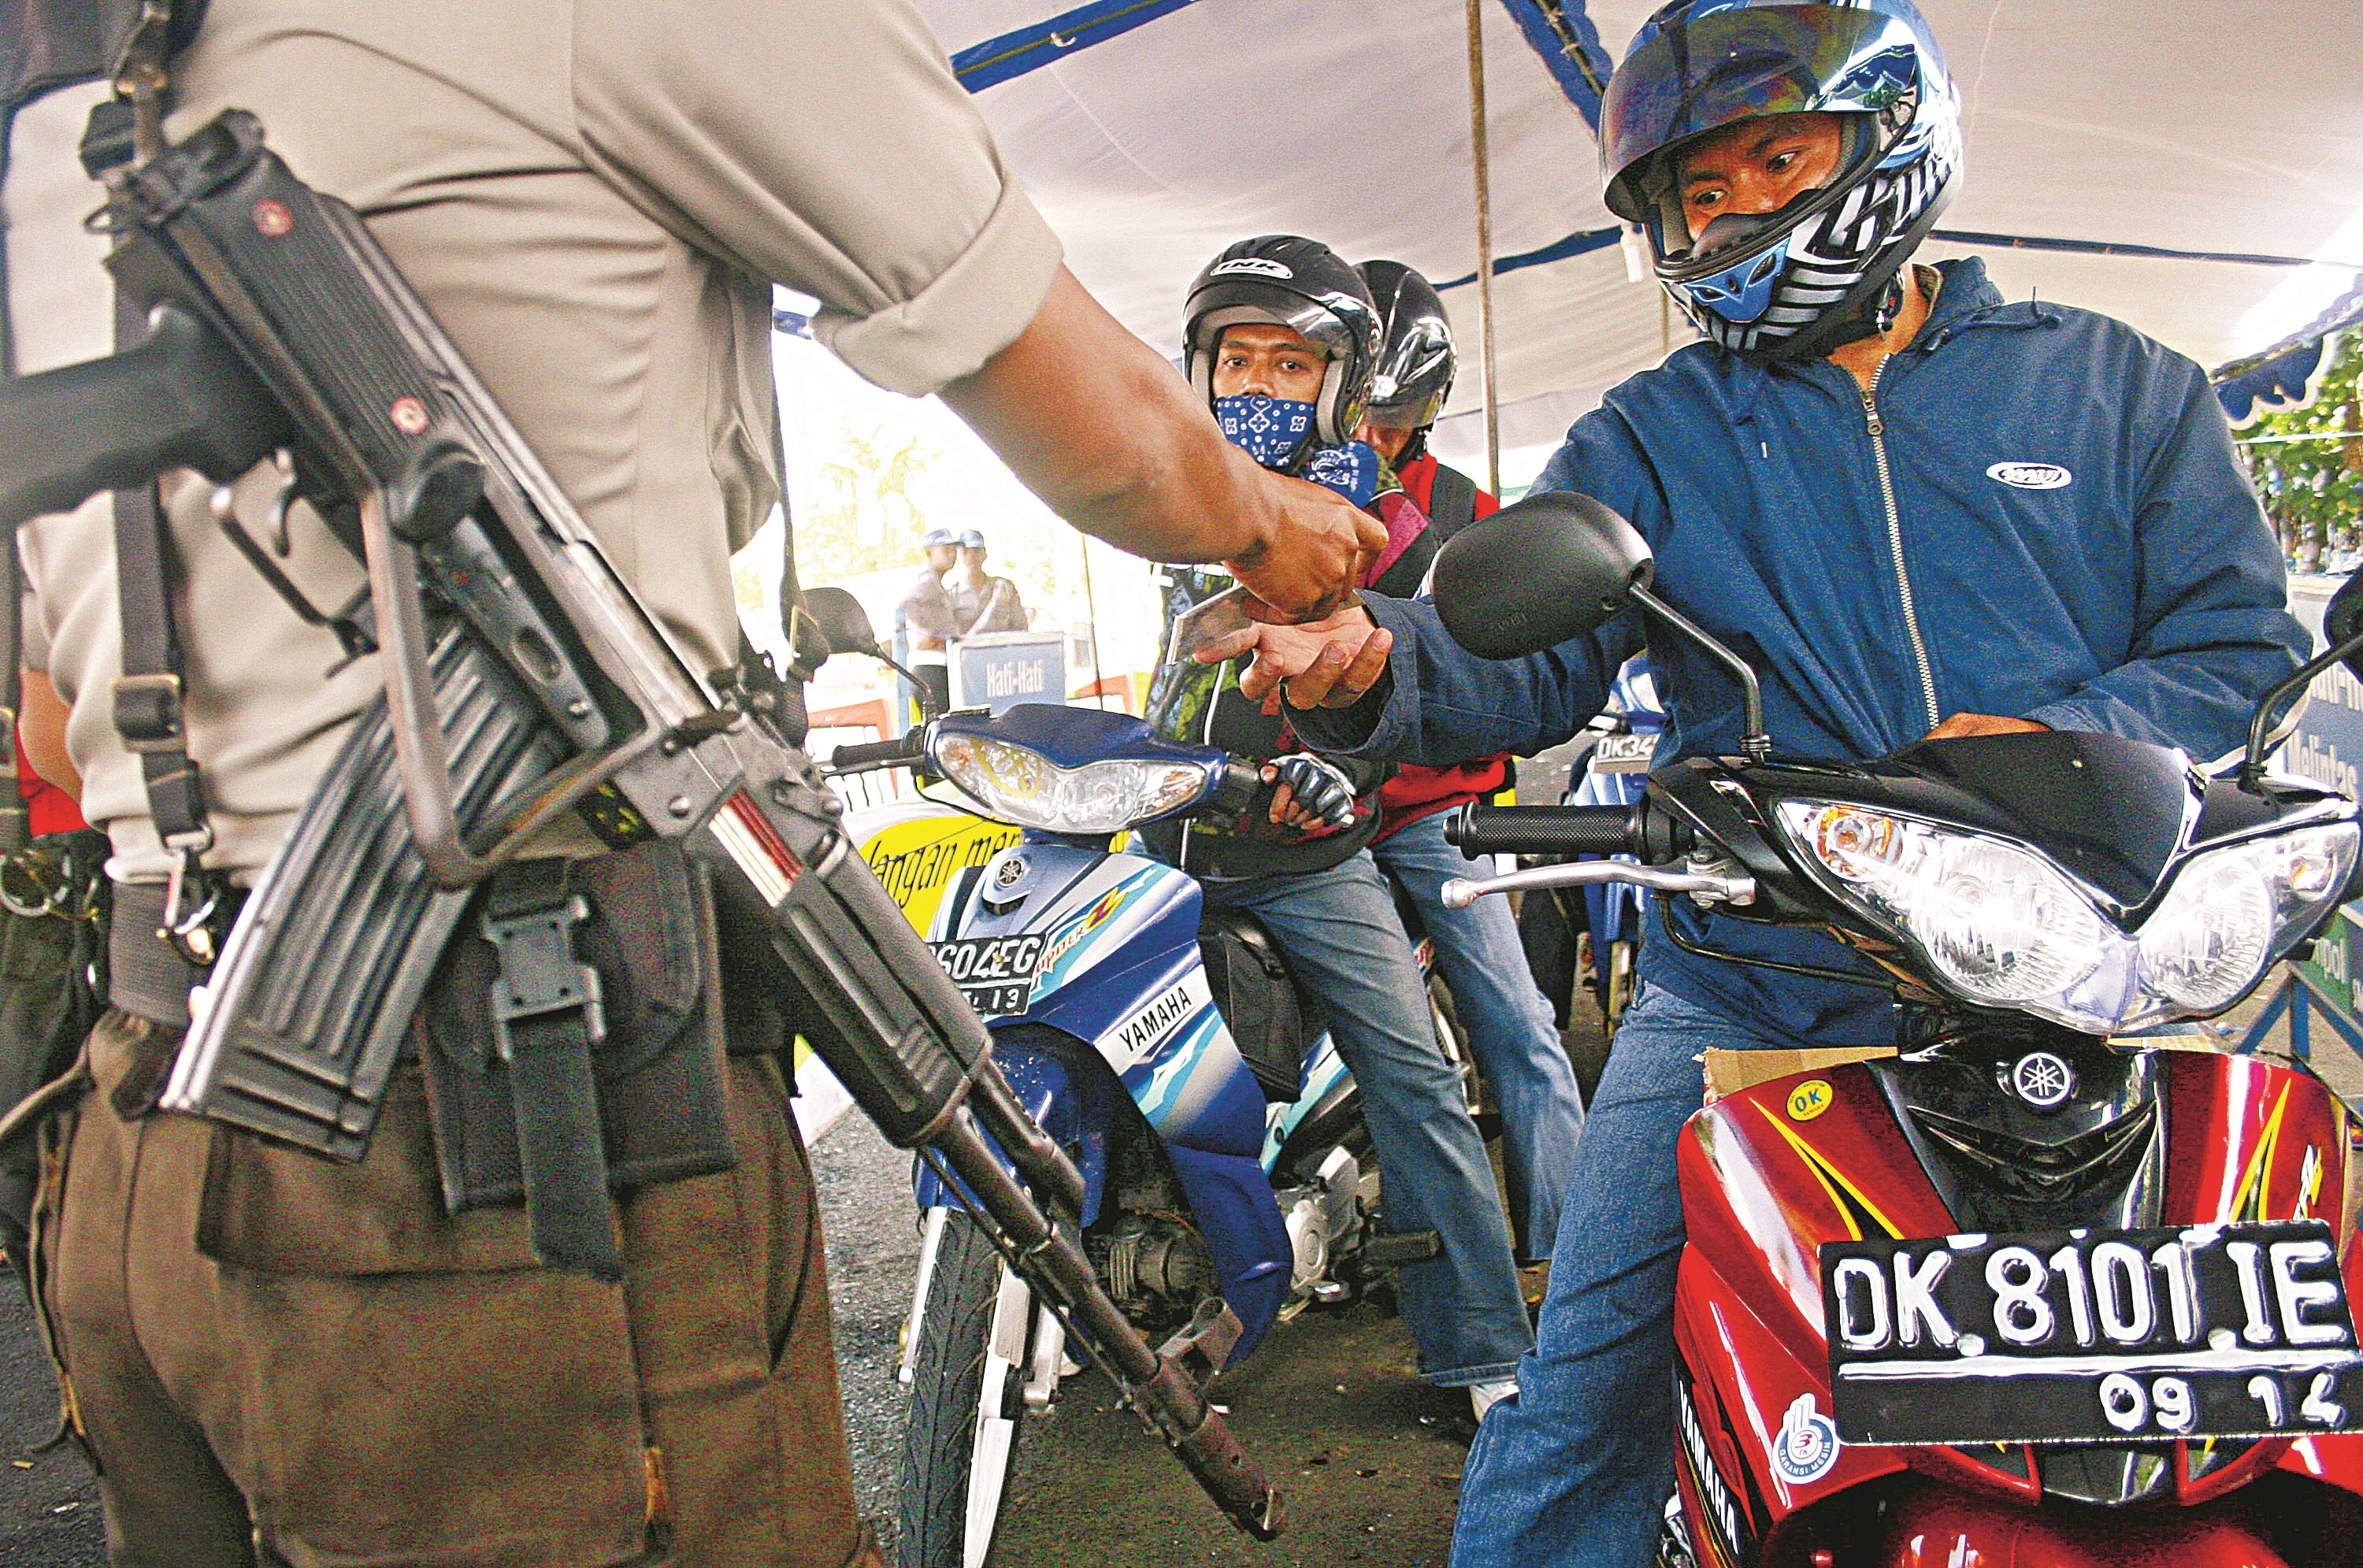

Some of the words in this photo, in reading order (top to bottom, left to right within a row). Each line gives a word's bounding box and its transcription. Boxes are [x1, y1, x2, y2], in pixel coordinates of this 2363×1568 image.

[986, 659, 1044, 697] Hati-Hati
[1118, 986, 1192, 1052] YAMAHA
[1794, 1088, 1823, 1113] OK
[2099, 1373, 2196, 1433] 09
[1679, 1380, 1739, 1555] YAMAHA
